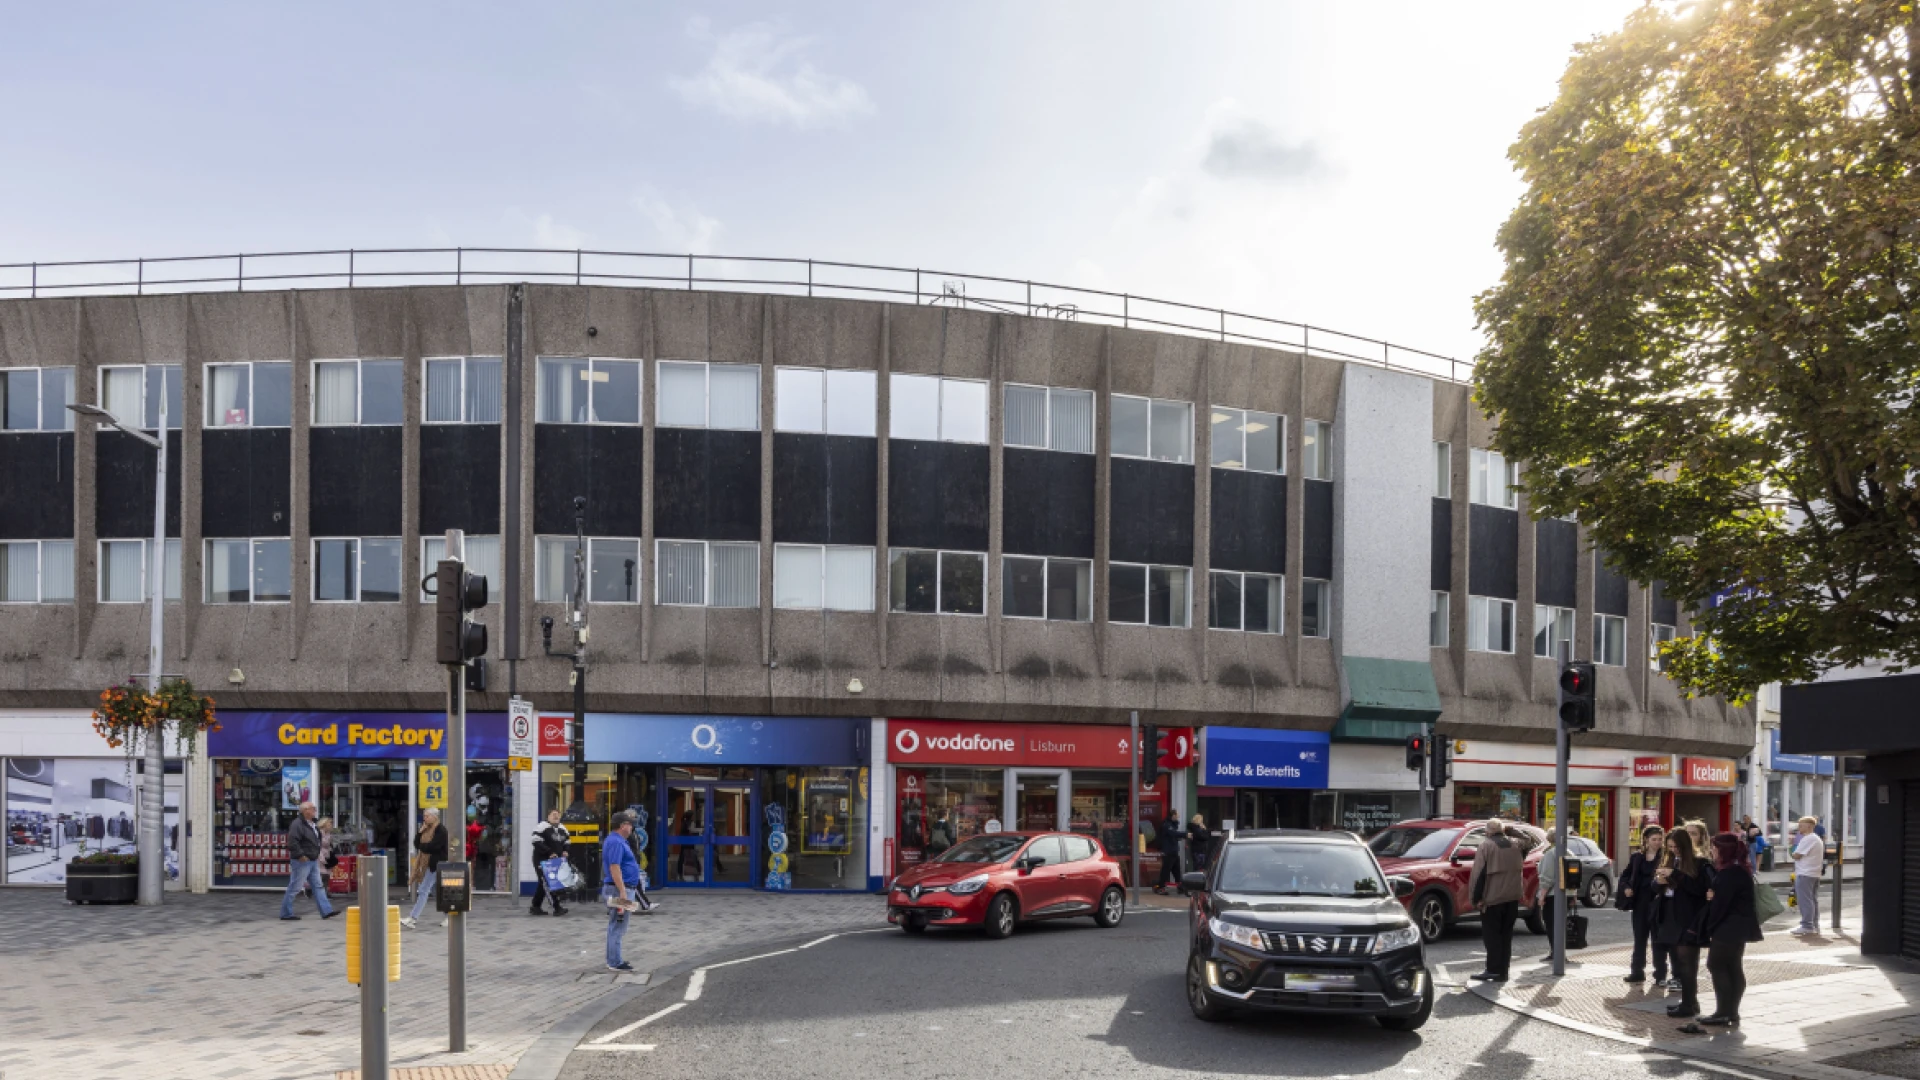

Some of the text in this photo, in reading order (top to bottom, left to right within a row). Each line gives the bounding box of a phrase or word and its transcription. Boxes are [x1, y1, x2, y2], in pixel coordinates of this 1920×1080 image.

[278, 722, 444, 750] Card Factory
[926, 733, 1076, 753] vodafone Lisburn
[1215, 763, 1301, 778] Jobs & Benefits
[1636, 763, 1670, 772] Iceland
[1693, 763, 1729, 783] Iceland
[425, 769, 443, 782] 10
[426, 786, 442, 799] £1
